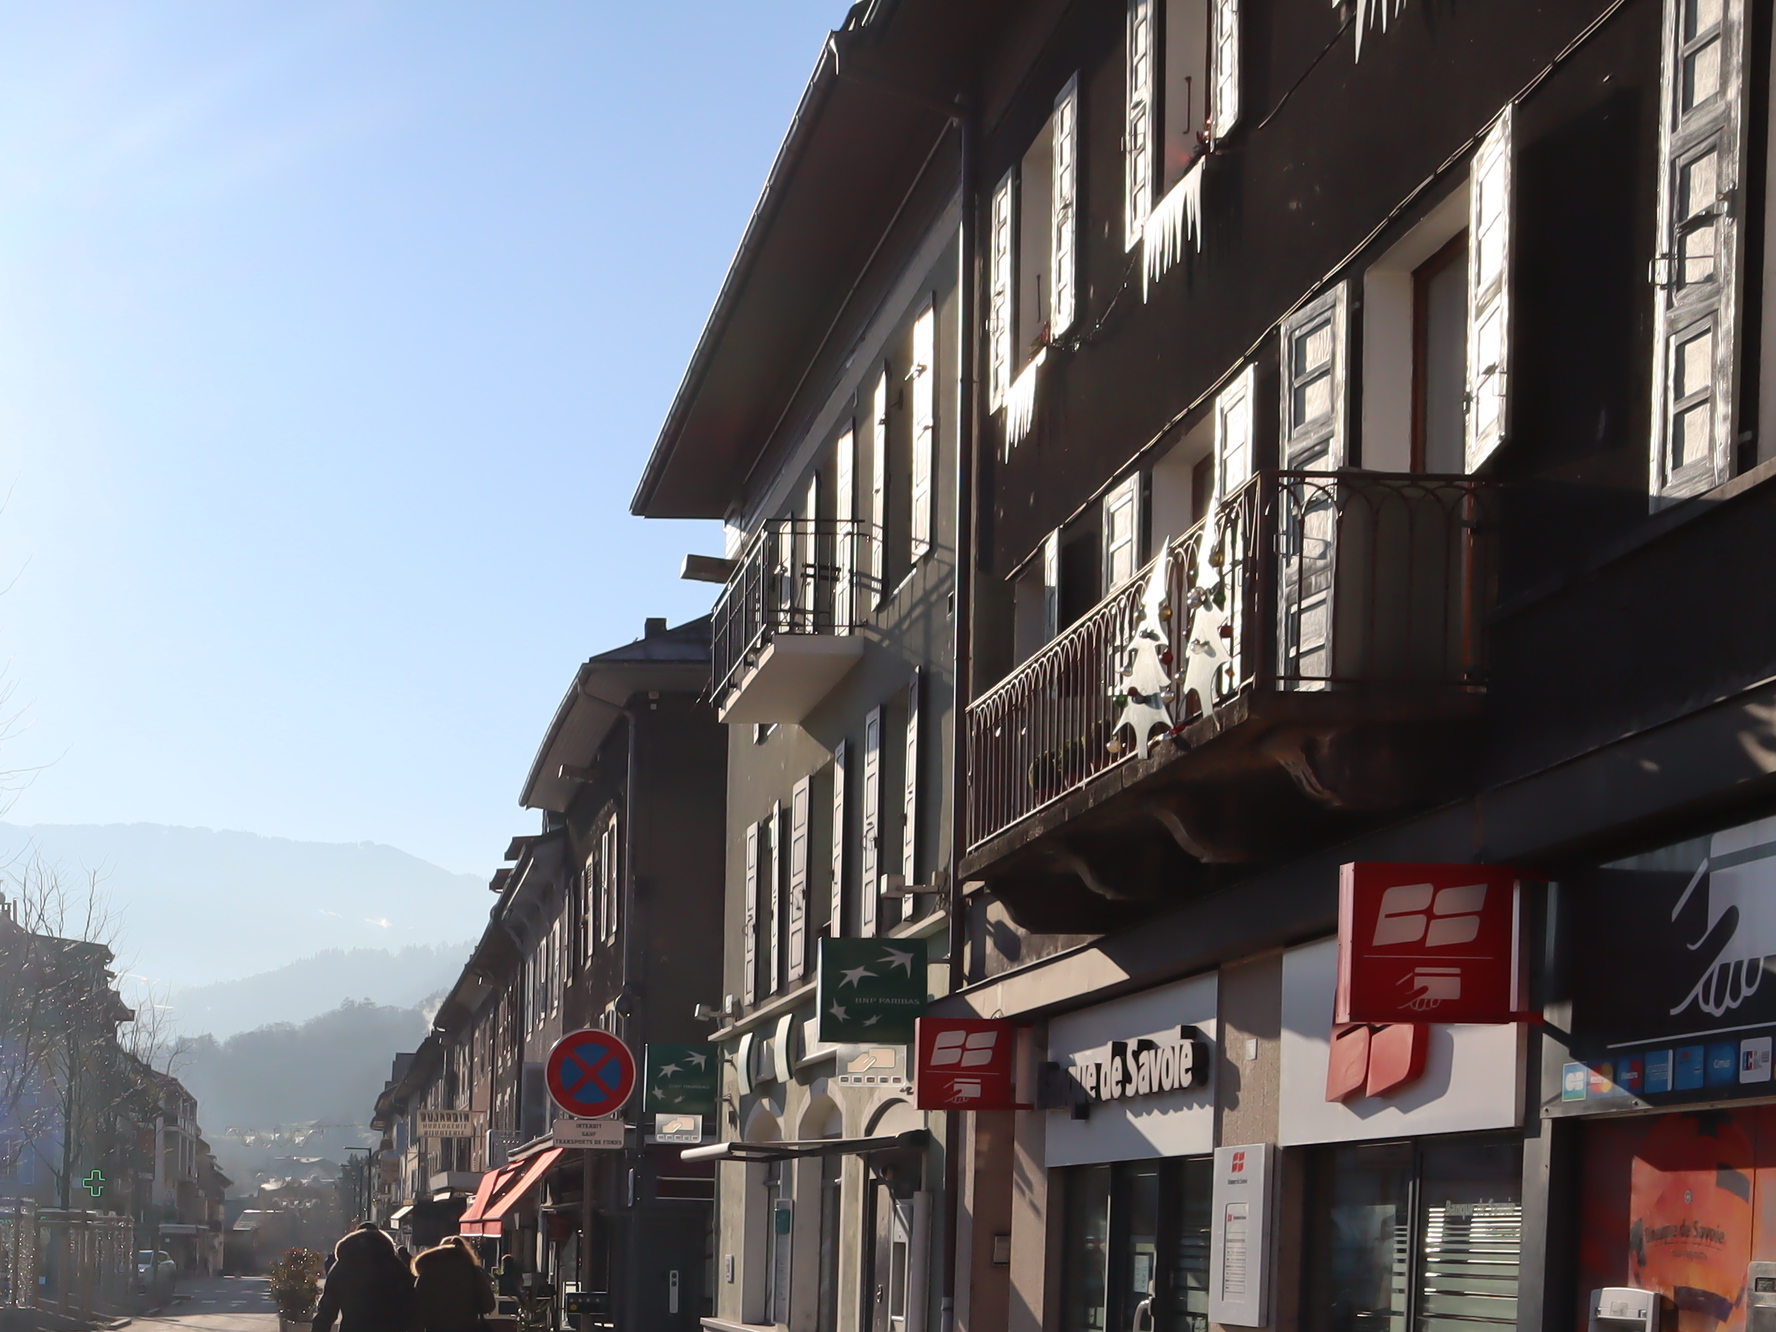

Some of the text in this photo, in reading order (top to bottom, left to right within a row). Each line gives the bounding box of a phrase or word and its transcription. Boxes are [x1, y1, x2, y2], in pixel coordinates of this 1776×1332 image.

[878, 997, 920, 1005] PARIBAS
[1100, 1040, 1123, 1101] de
[1125, 1030, 1194, 1098] Savoie
[420, 1112, 469, 1122] DUJARDIN
